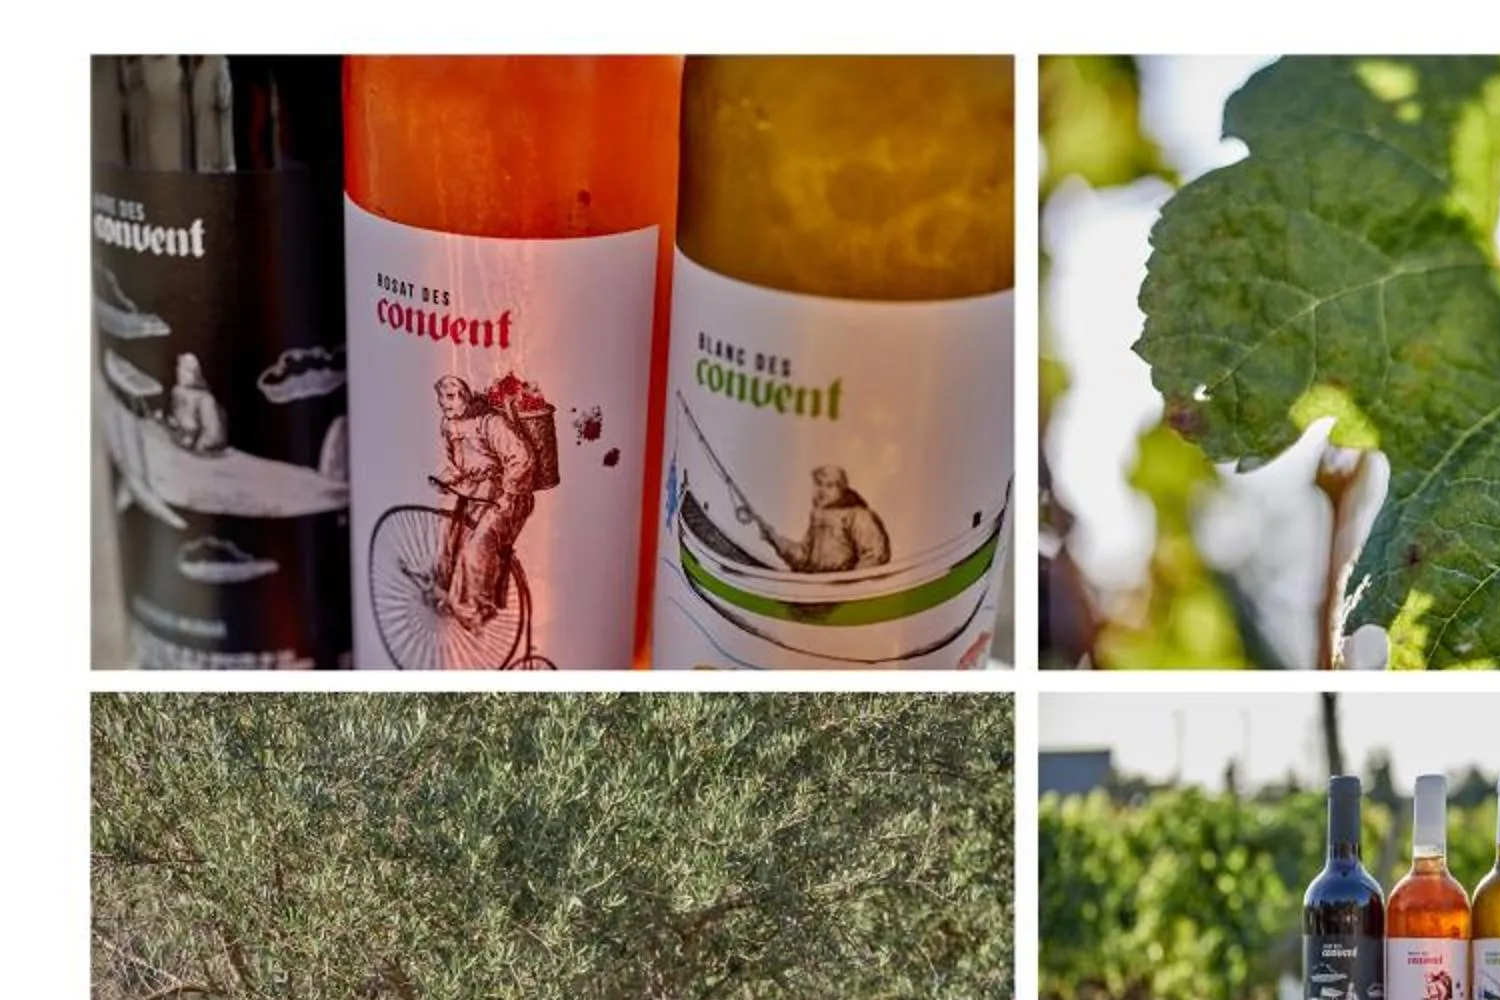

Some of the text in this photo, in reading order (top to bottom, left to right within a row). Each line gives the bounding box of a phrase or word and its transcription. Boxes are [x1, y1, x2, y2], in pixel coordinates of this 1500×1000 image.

[377, 272, 450, 306] ROSAT DES
[377, 298, 512, 349] convent
[698, 332, 791, 377] BLANC DES
[696, 358, 842, 421] convent
